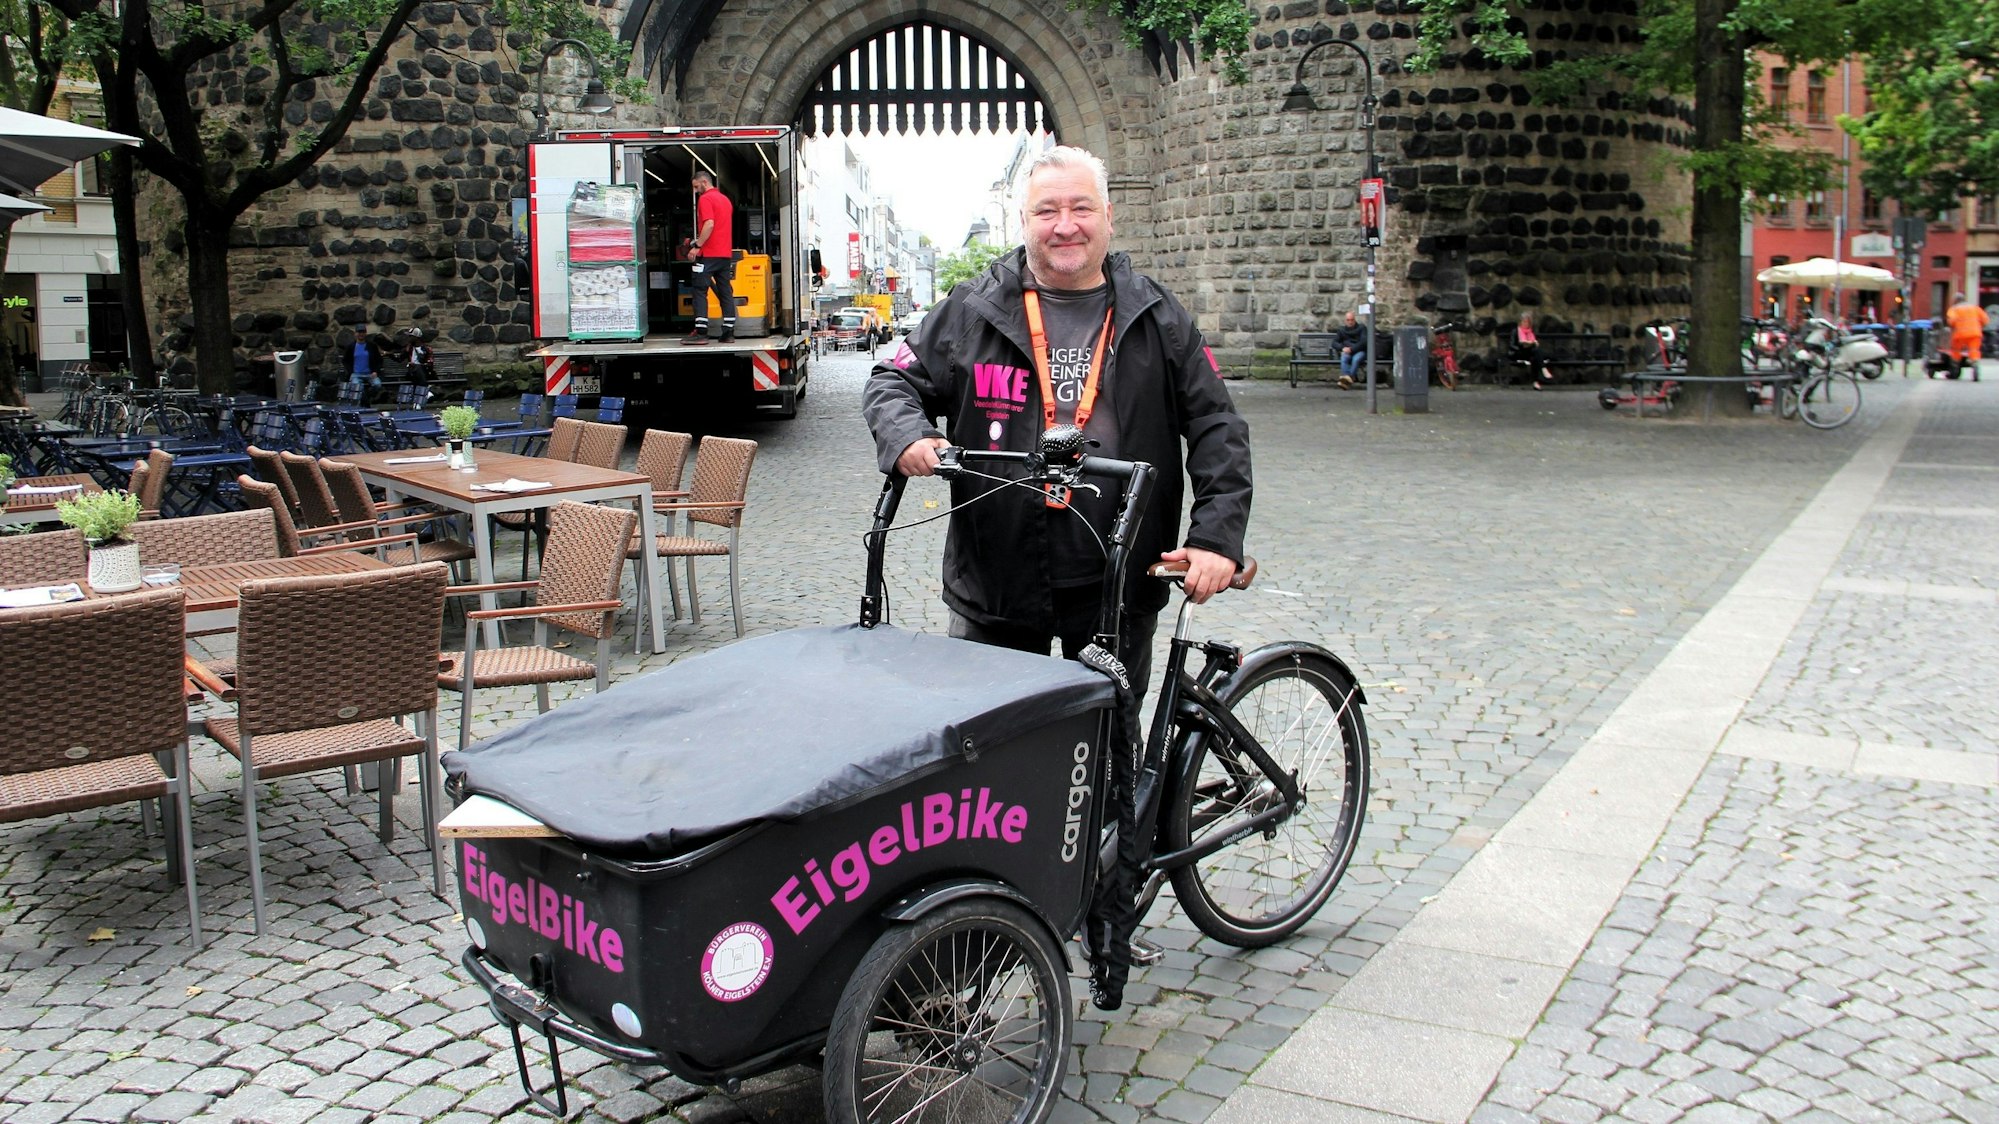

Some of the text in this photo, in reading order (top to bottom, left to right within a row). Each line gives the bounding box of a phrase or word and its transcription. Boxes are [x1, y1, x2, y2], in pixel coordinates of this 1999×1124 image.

[849, 240, 860, 271] REWE
[1047, 347, 1092, 363] IGELS
[583, 377, 589, 385] K
[973, 363, 1030, 403] VKE
[1048, 363, 1091, 380] EINER
[585, 385, 599, 393] 582
[1161, 724, 1173, 762] winther
[1061, 741, 1092, 863] cargoo
[770, 787, 1028, 935] EigelBike
[463, 841, 625, 973] EigelBike
[707, 924, 768, 956] BÜRGERVEREIN
[702, 970, 725, 999] KÖLNER
[723, 970, 767, 1000] EIGELSTEIN
